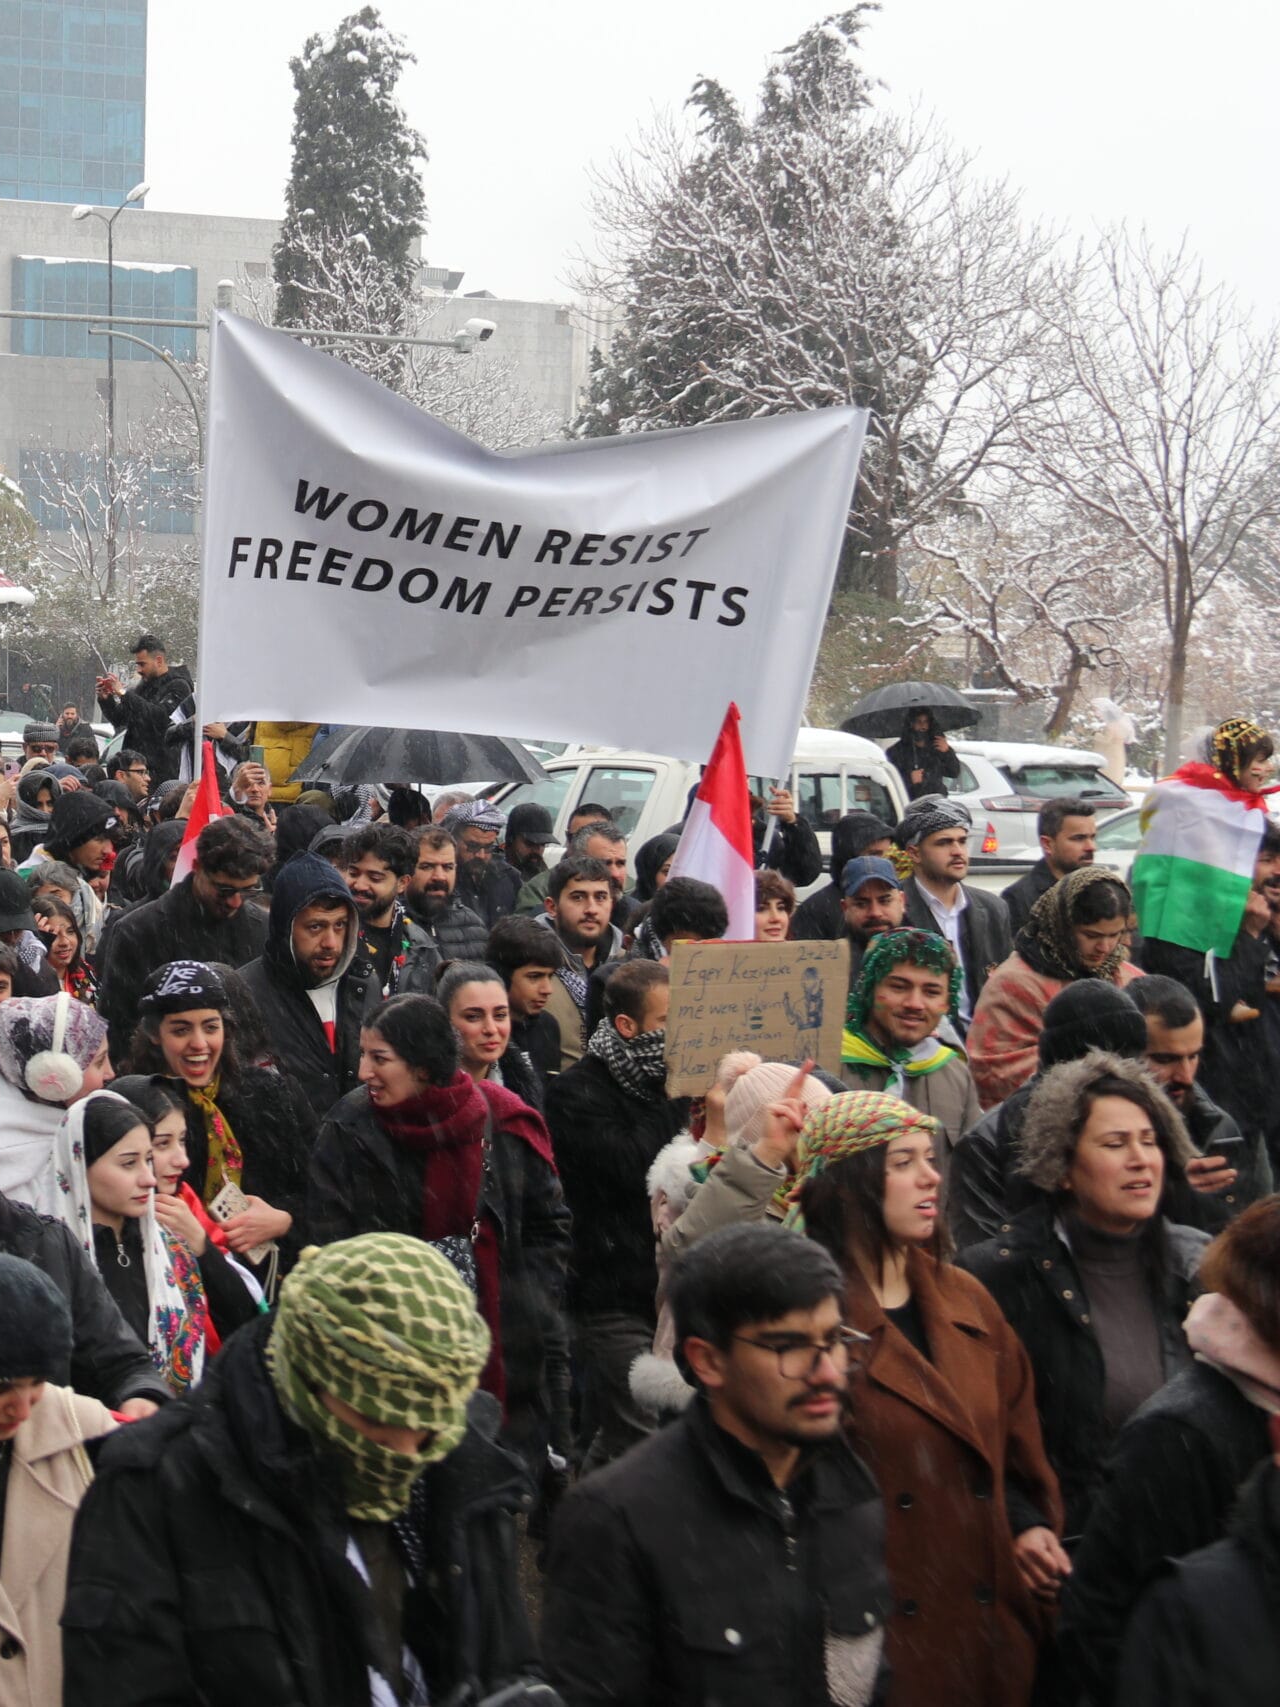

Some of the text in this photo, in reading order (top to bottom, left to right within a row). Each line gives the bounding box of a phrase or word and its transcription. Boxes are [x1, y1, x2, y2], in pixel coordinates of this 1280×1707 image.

[294, 478, 711, 567] WOMEN RESIST
[228, 536, 749, 628] FREEDOM PERSISTS
